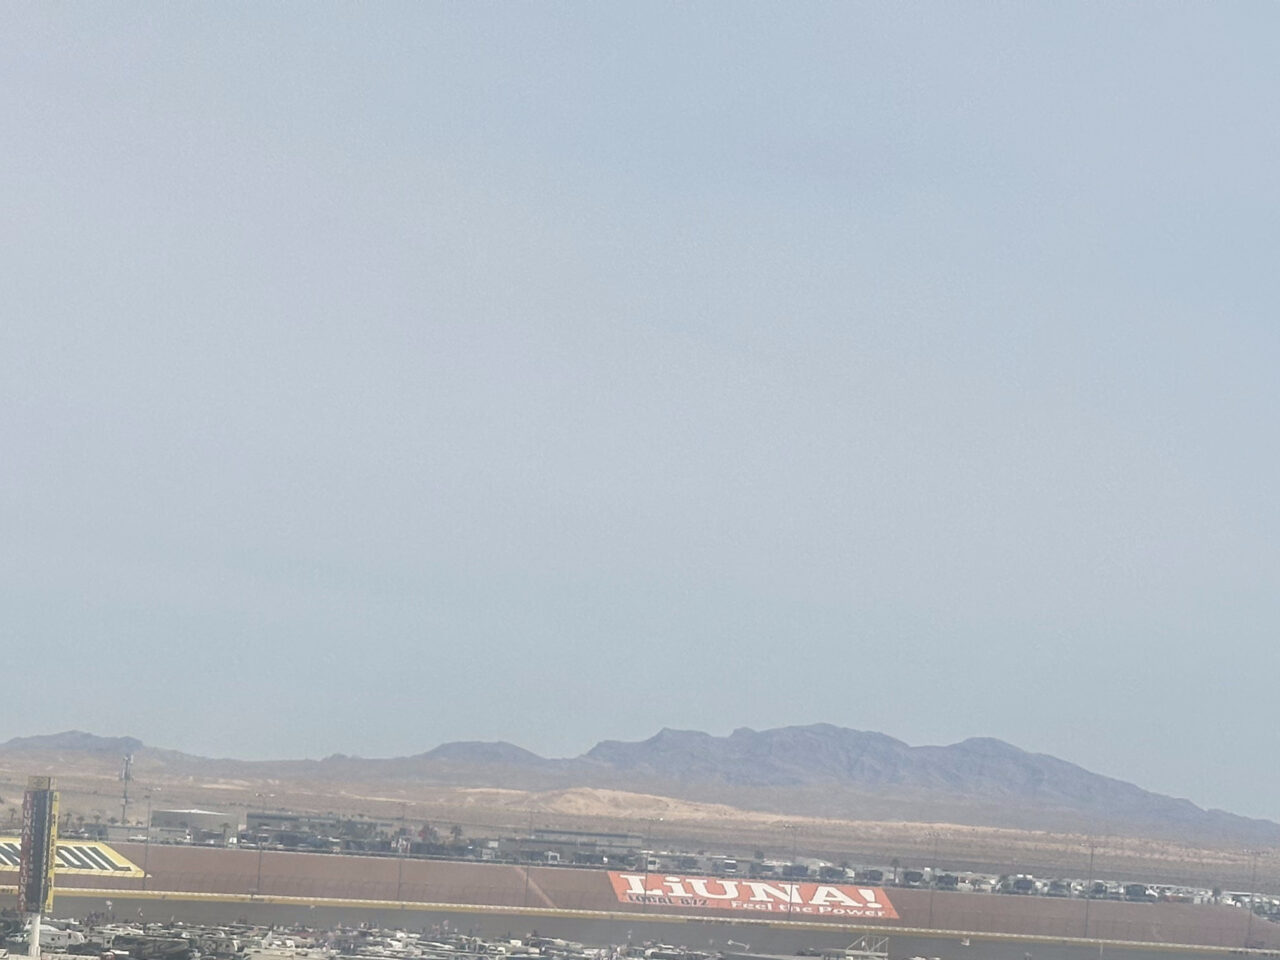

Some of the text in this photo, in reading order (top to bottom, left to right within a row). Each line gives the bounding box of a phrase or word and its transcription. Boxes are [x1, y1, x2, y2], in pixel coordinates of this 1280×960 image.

[731, 900, 886, 917] Feel the Power
